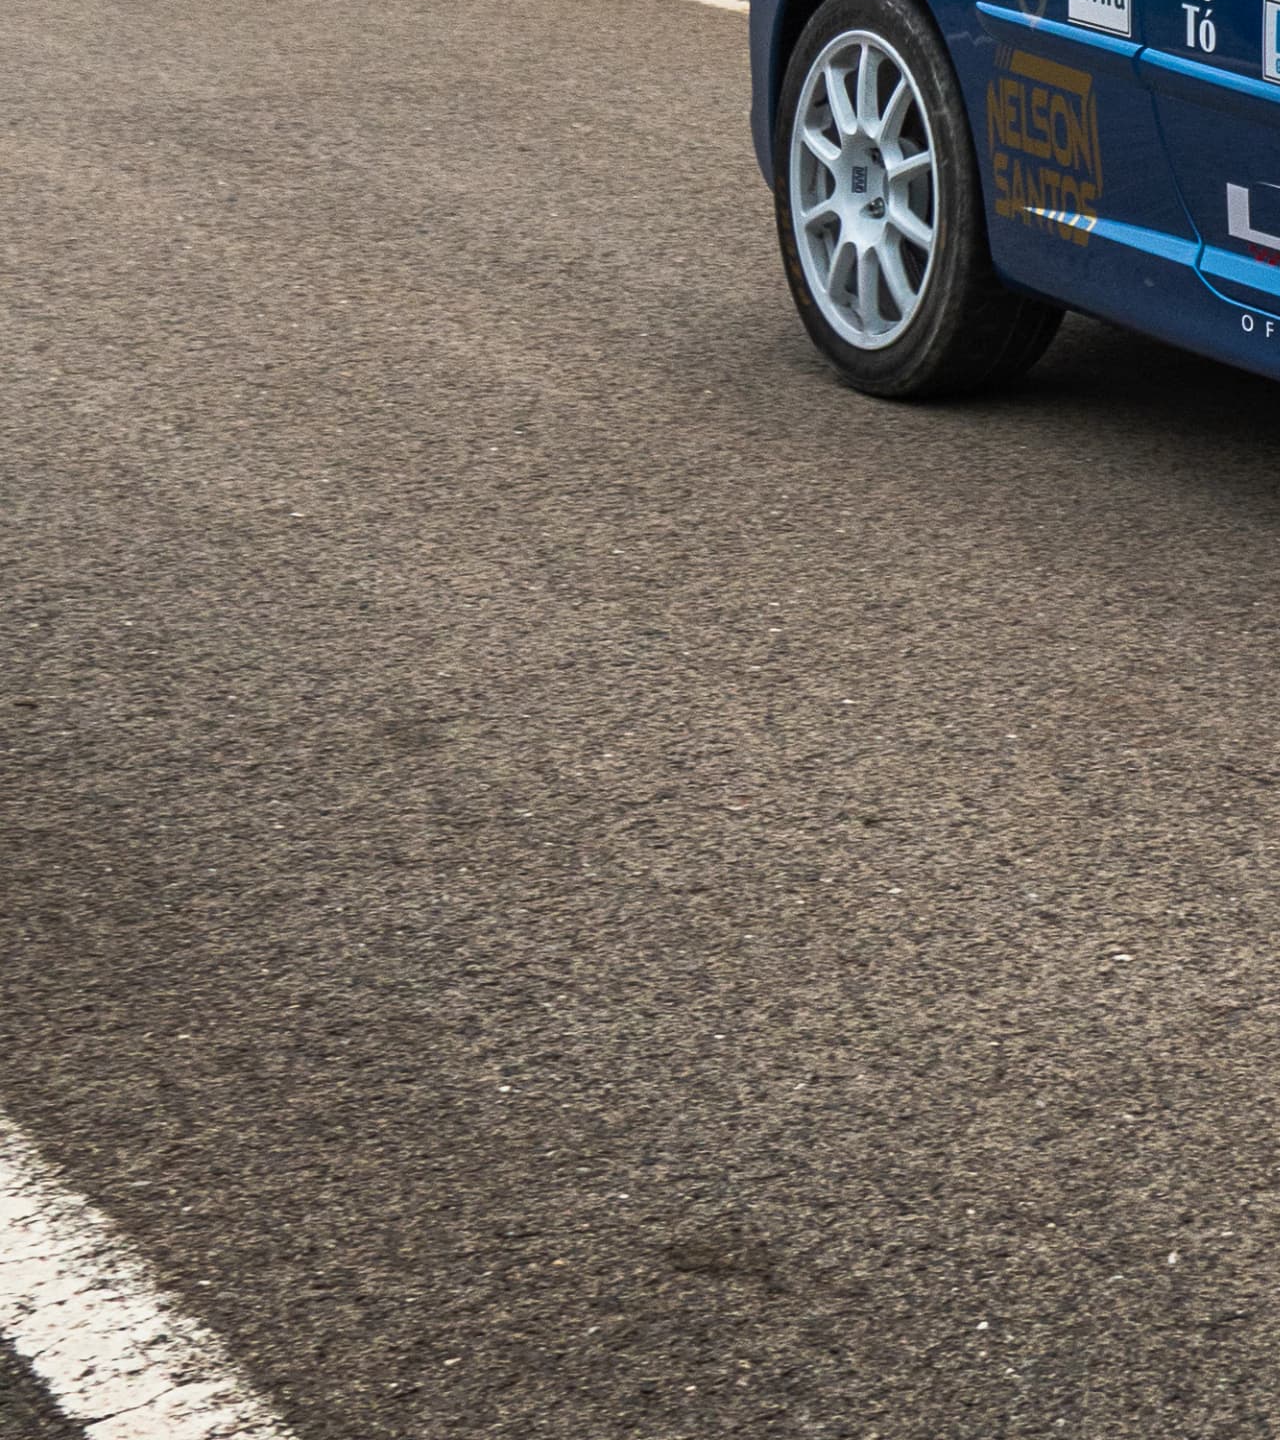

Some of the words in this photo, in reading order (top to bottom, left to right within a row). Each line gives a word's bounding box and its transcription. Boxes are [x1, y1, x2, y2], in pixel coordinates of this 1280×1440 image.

[1181, 2, 1217, 53] Tó
[986, 78, 1097, 177] NELSON
[993, 152, 1098, 248] SANTOS
